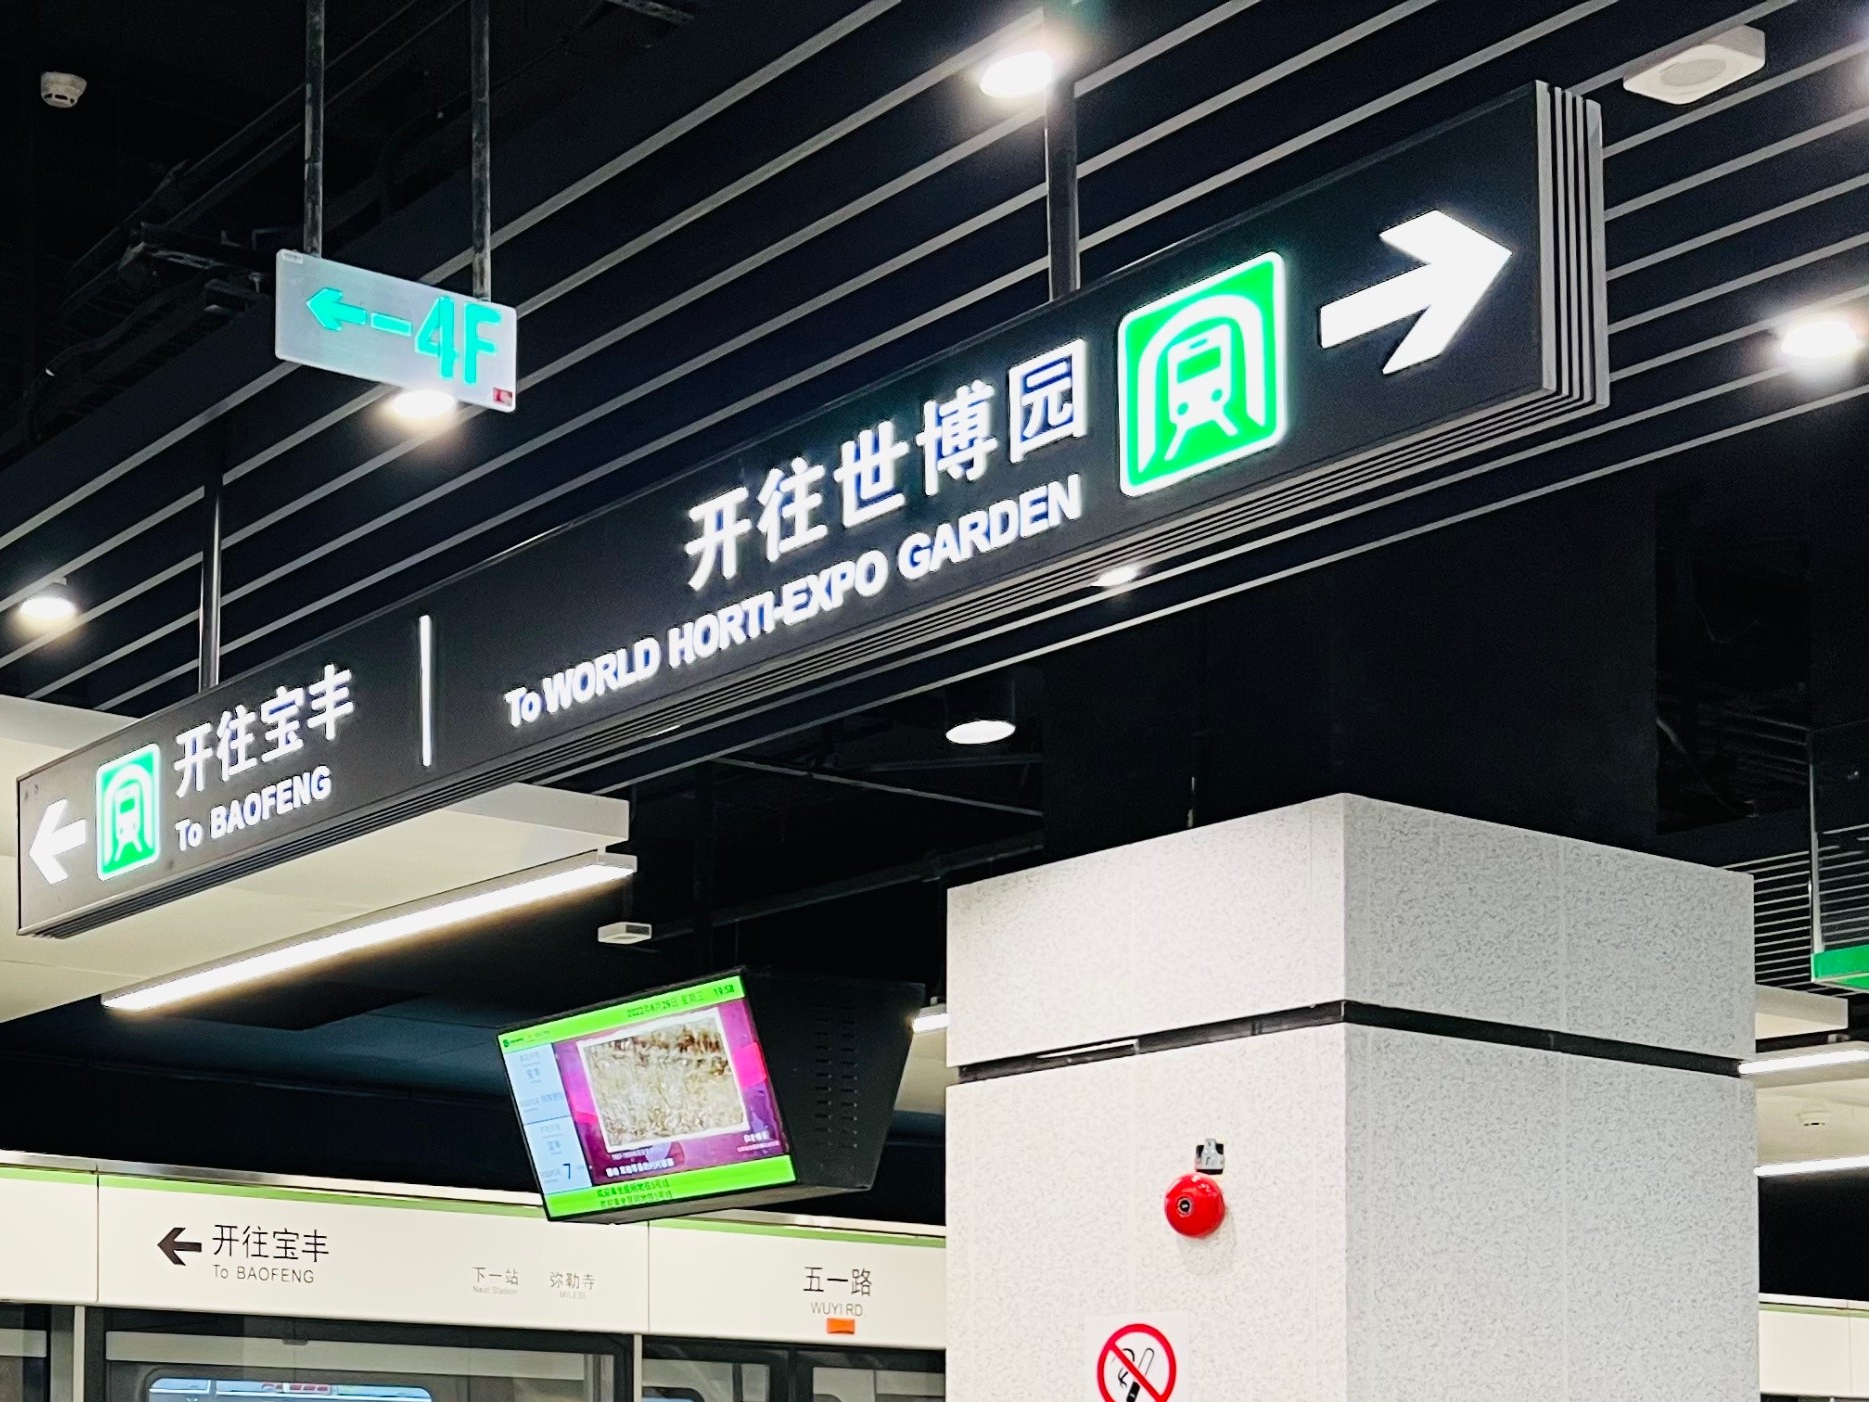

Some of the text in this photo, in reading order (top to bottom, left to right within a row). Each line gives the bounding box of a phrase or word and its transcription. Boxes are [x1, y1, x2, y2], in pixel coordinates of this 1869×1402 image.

[415, 295, 503, 385] 4F
[683, 337, 1087, 592] 开往世博园
[505, 474, 1082, 728] To WORLD HORTI-EXPO GARDEN
[174, 663, 355, 798] 开往宝丰
[175, 765, 332, 851] To BAOFENG
[212, 1224, 330, 1263] 开往宝丰
[213, 1264, 315, 1284] To BAOFENG
[472, 1266, 596, 1291] 下一站 弥勒寺
[802, 1267, 873, 1297] 五一路
